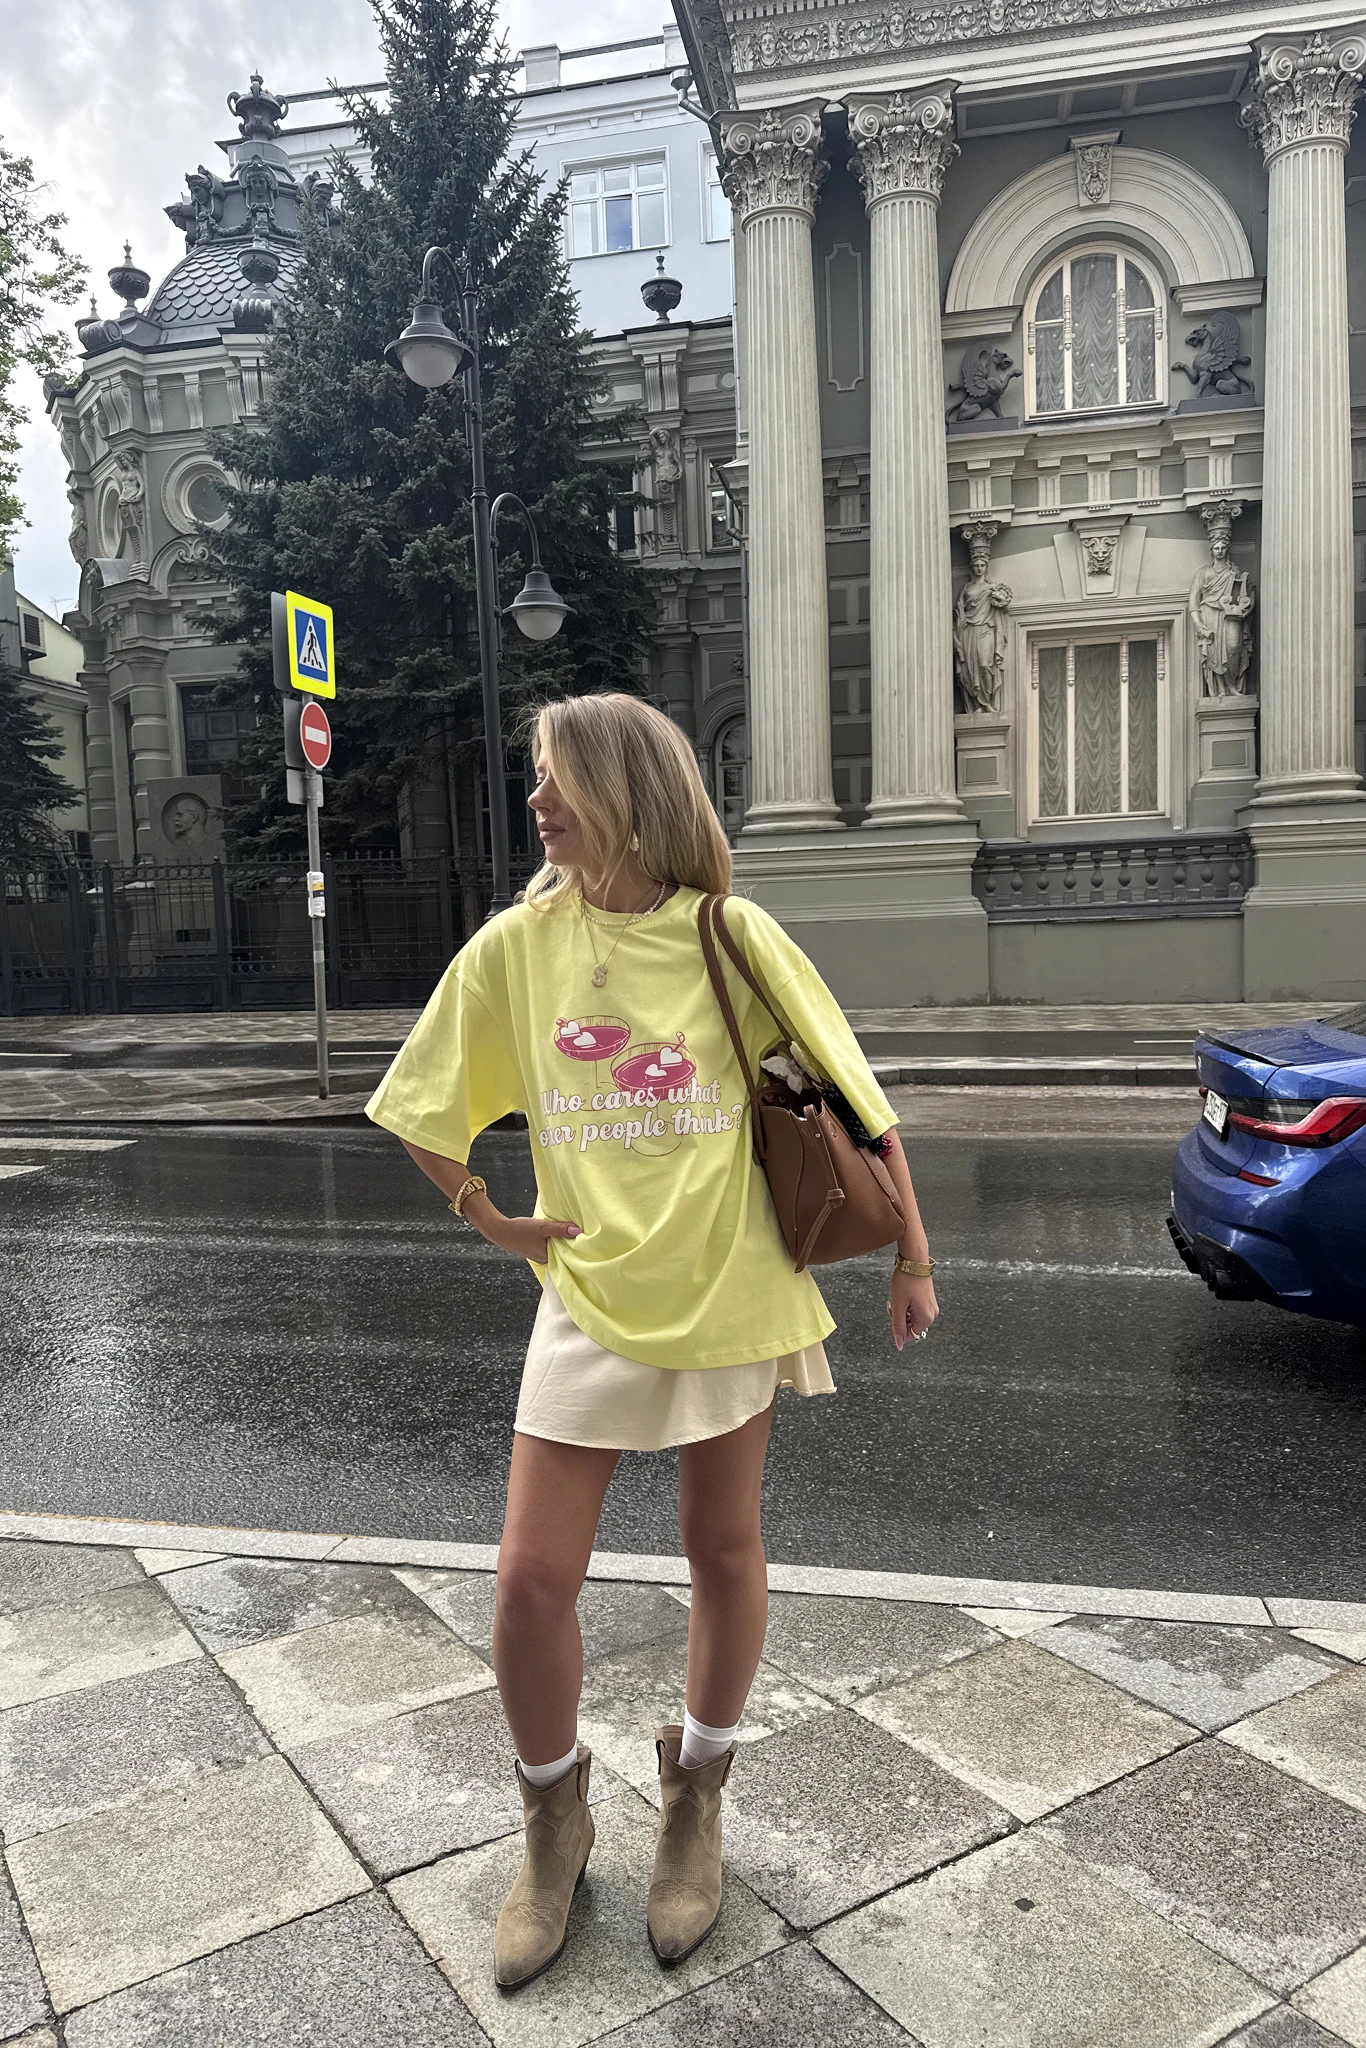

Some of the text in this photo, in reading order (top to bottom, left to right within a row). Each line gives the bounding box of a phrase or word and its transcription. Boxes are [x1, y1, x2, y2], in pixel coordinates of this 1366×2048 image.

[540, 1076, 721, 1117] Who cares what
[578, 1109, 669, 1152] people
[671, 1103, 744, 1136] think?
